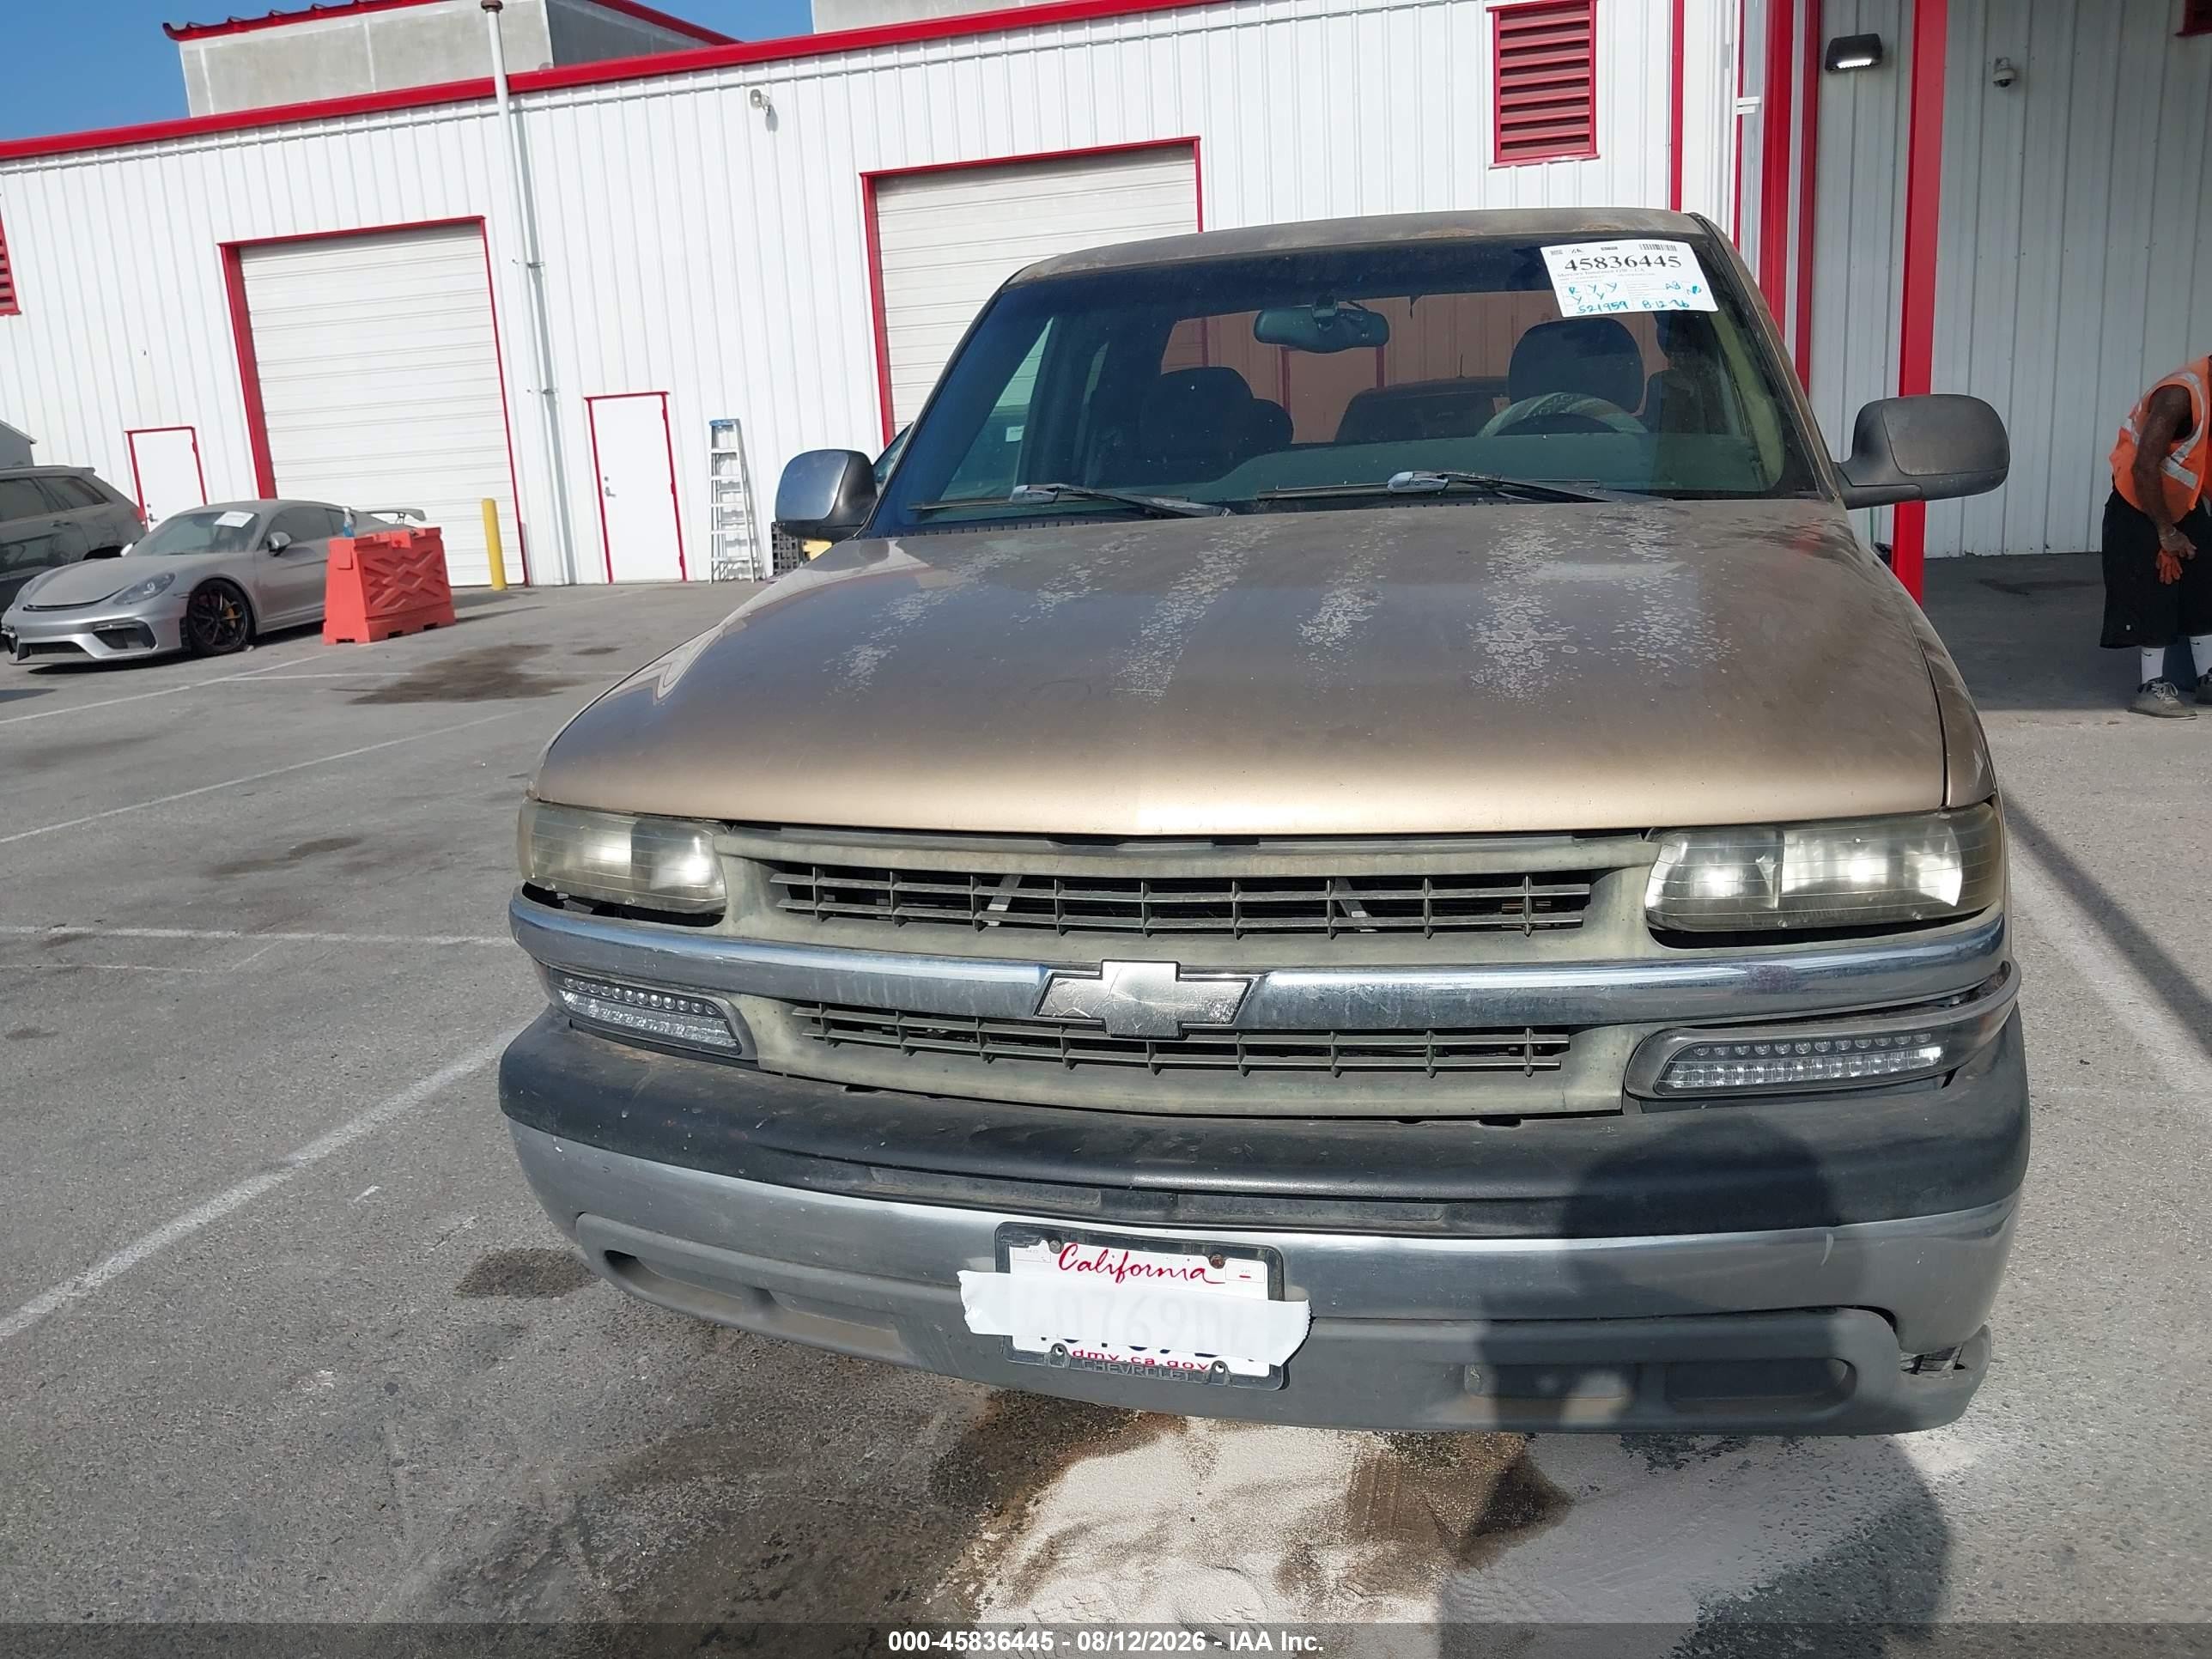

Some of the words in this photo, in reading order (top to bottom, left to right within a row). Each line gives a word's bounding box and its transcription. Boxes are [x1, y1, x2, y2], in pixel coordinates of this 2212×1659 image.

[1565, 255, 1682, 271] 45836445
[1577, 301, 1629, 313] 521959
[1058, 1243, 1225, 1284] California
[1082, 1359, 1191, 1382] CHEVROLET
